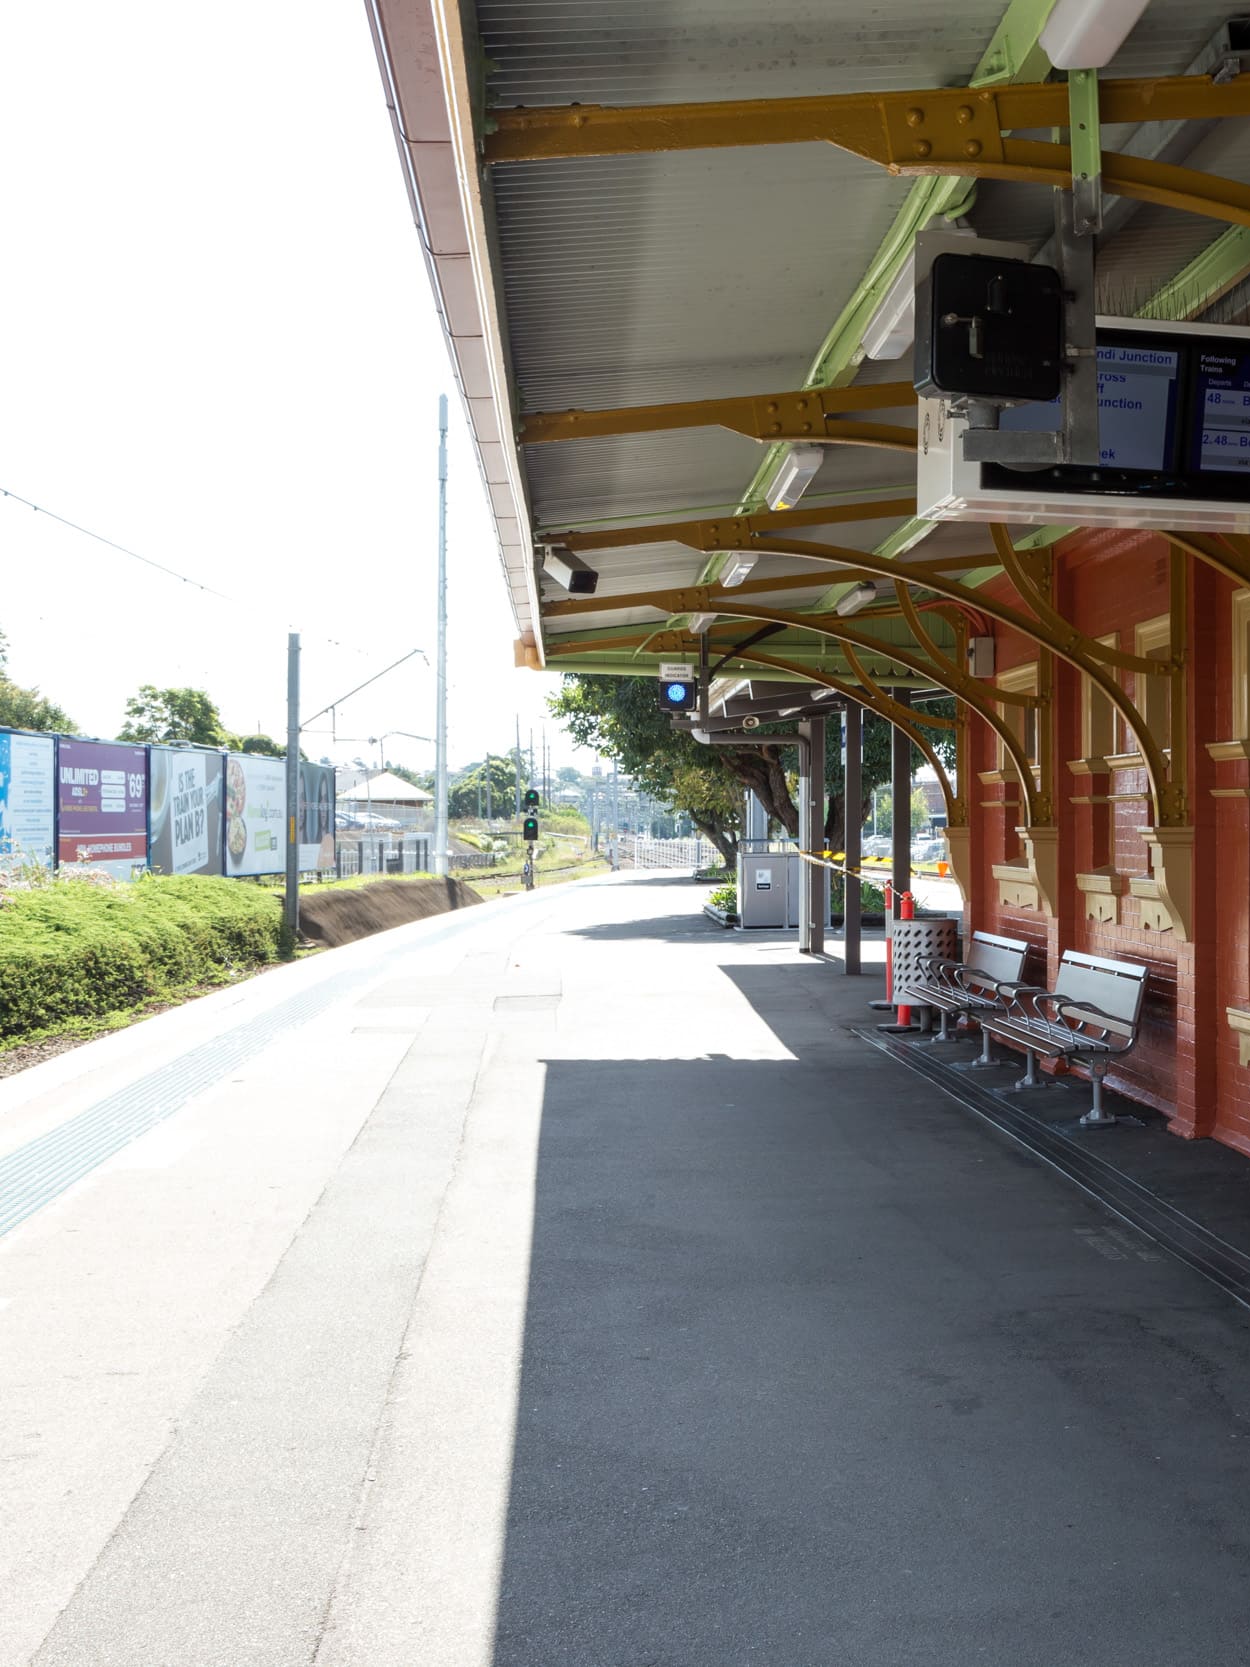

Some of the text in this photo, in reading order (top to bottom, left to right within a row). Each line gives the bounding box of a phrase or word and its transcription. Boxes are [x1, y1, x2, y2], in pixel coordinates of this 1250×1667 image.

[1096, 349, 1172, 365] ndi Junction
[1200, 355, 1237, 365] Following
[1200, 365, 1223, 373] Trains
[1097, 397, 1143, 410] unction
[1207, 392, 1222, 404] 48
[60, 766, 99, 785] UNLIMITED
[178, 768, 196, 792] IS THE
[173, 792, 190, 818] TRAIN
[190, 786, 204, 811] YOUR
[175, 808, 205, 848] PLAN B?
